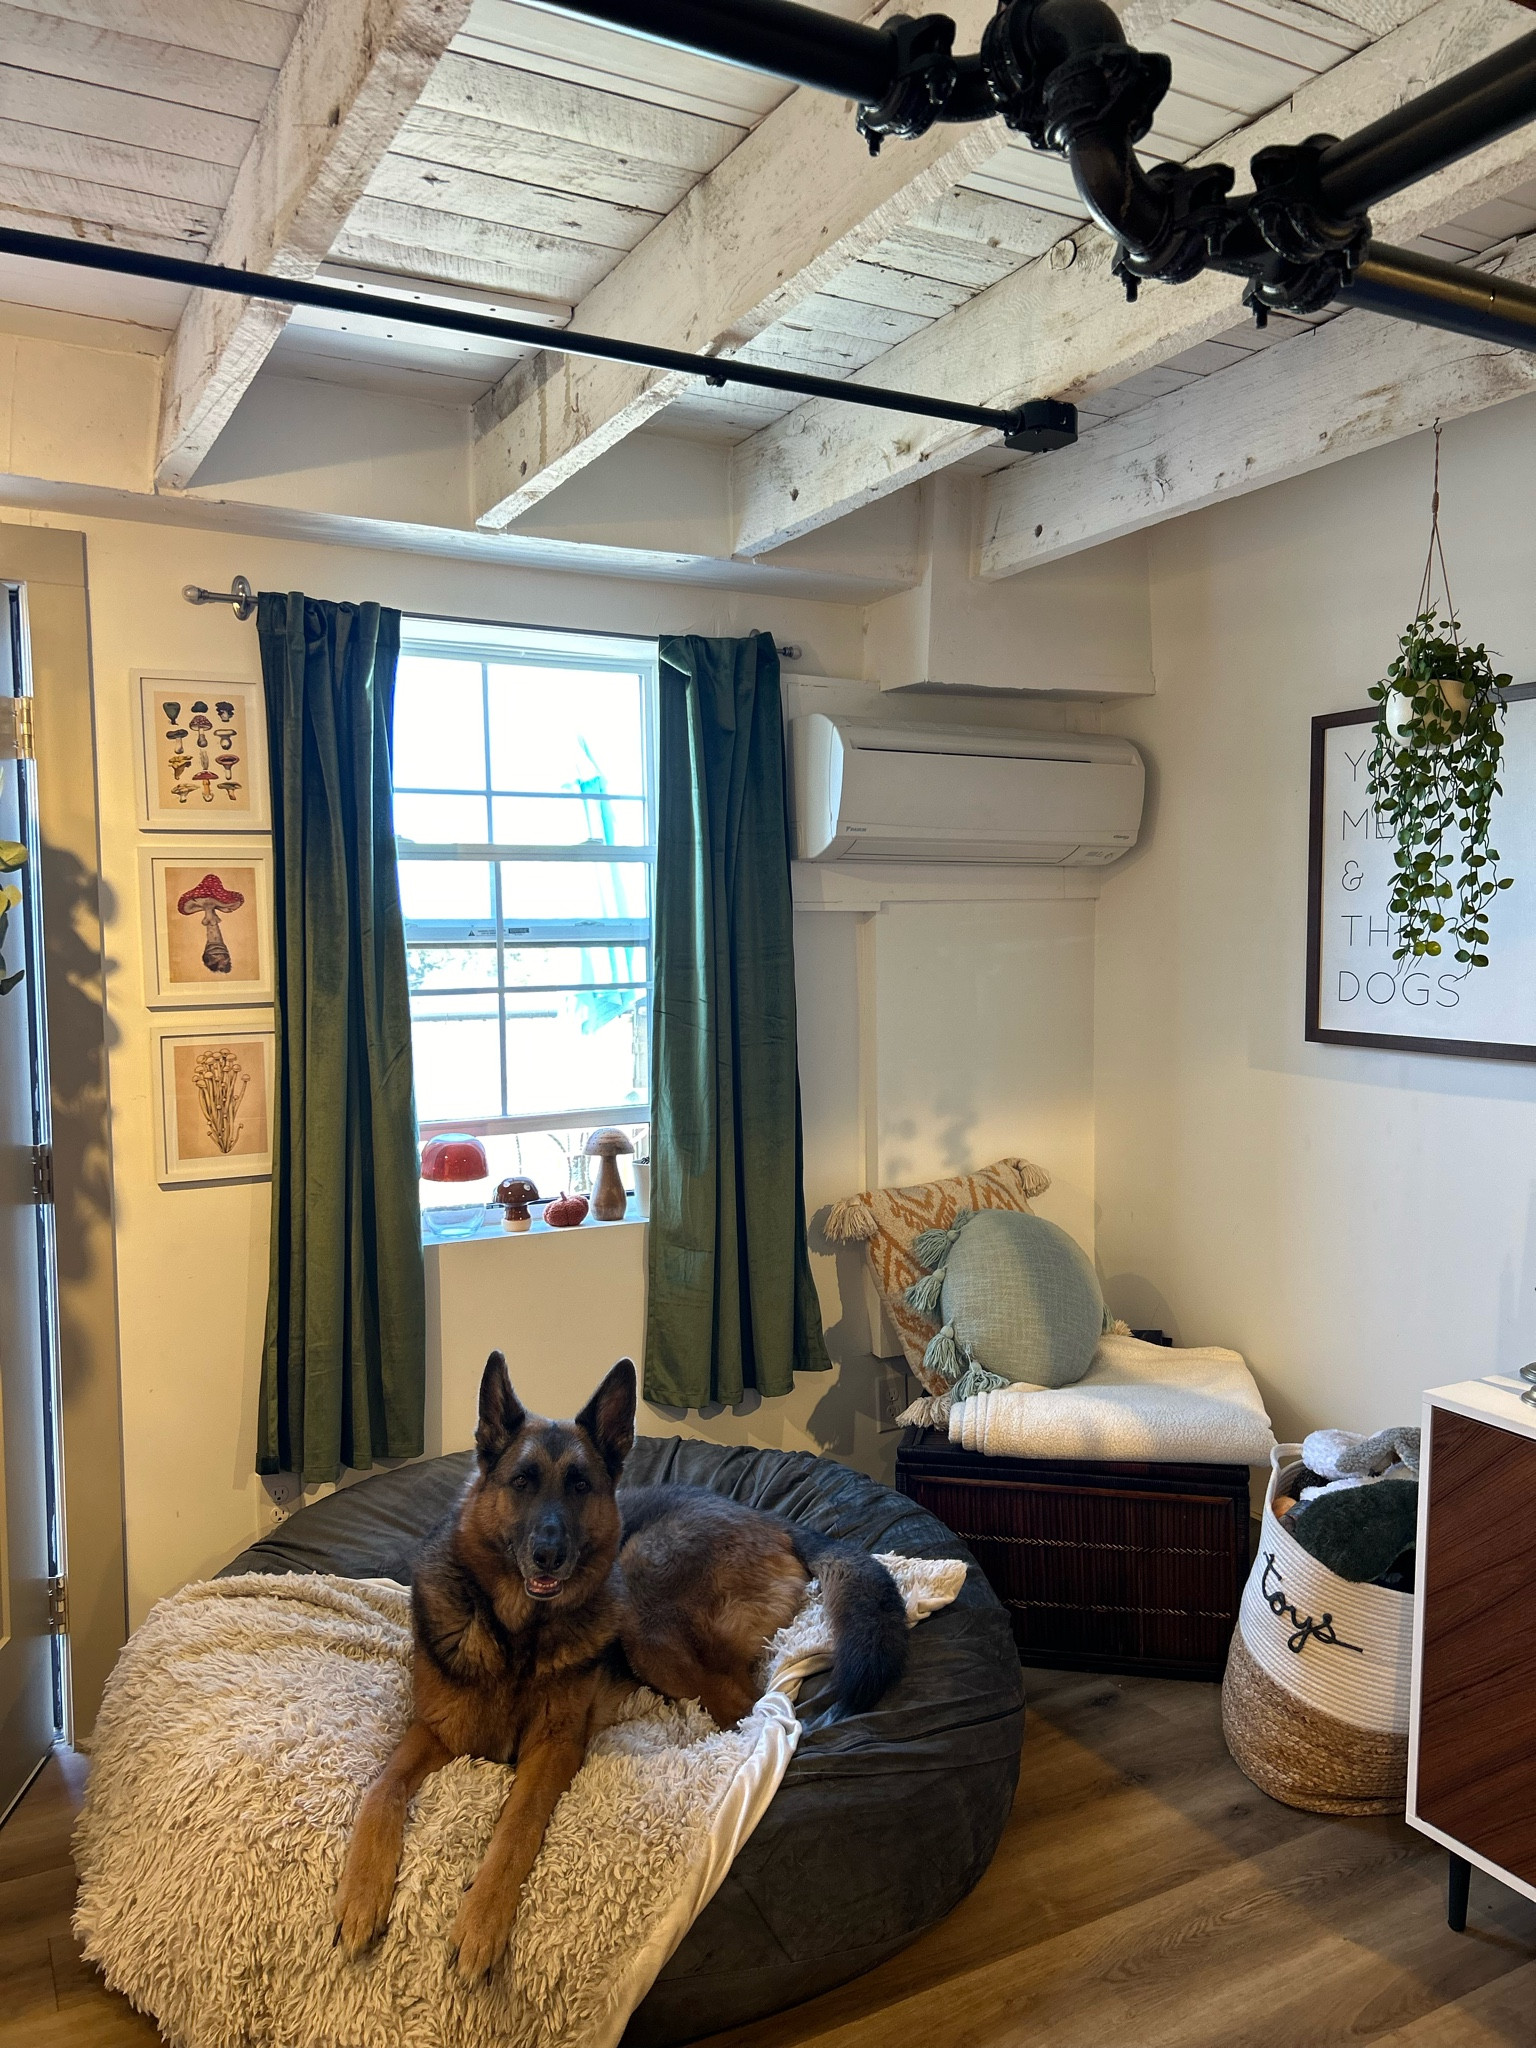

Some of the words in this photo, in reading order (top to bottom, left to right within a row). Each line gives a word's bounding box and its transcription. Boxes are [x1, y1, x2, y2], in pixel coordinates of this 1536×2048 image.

[1341, 860, 1364, 892] &
[1338, 970, 1460, 1008] DOGS
[1262, 1550, 1364, 1655] toys
